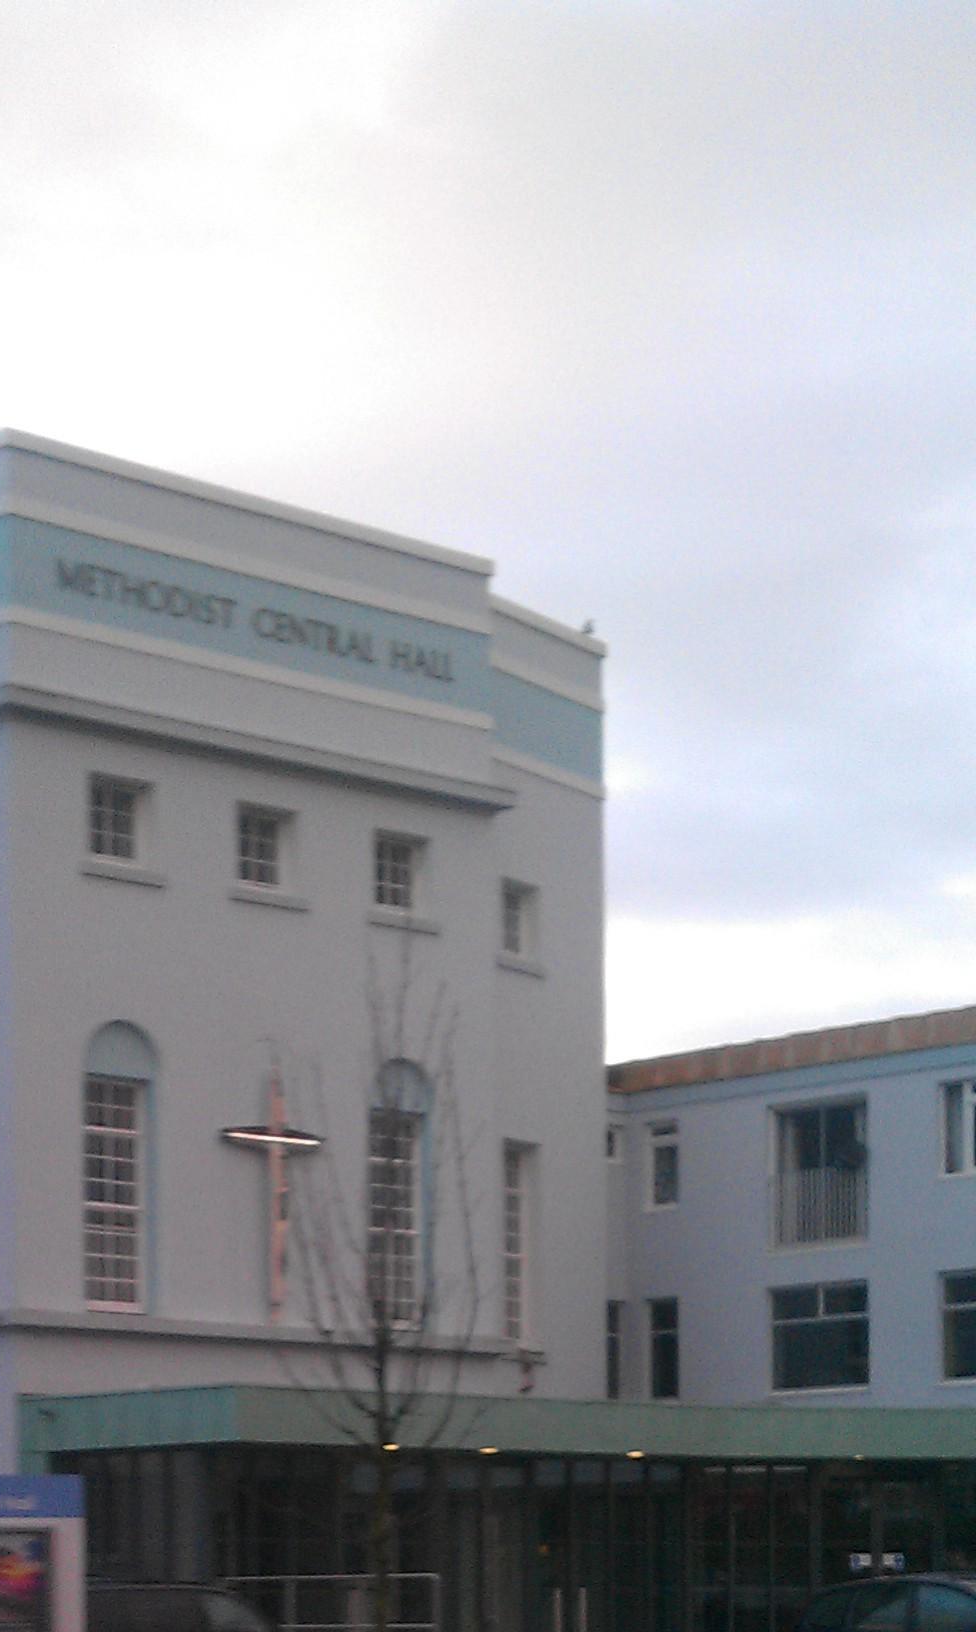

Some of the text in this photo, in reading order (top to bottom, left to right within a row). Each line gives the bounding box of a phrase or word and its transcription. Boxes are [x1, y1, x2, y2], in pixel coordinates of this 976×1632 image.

[56, 558, 454, 682] METHODIST CENTRAL HALL
